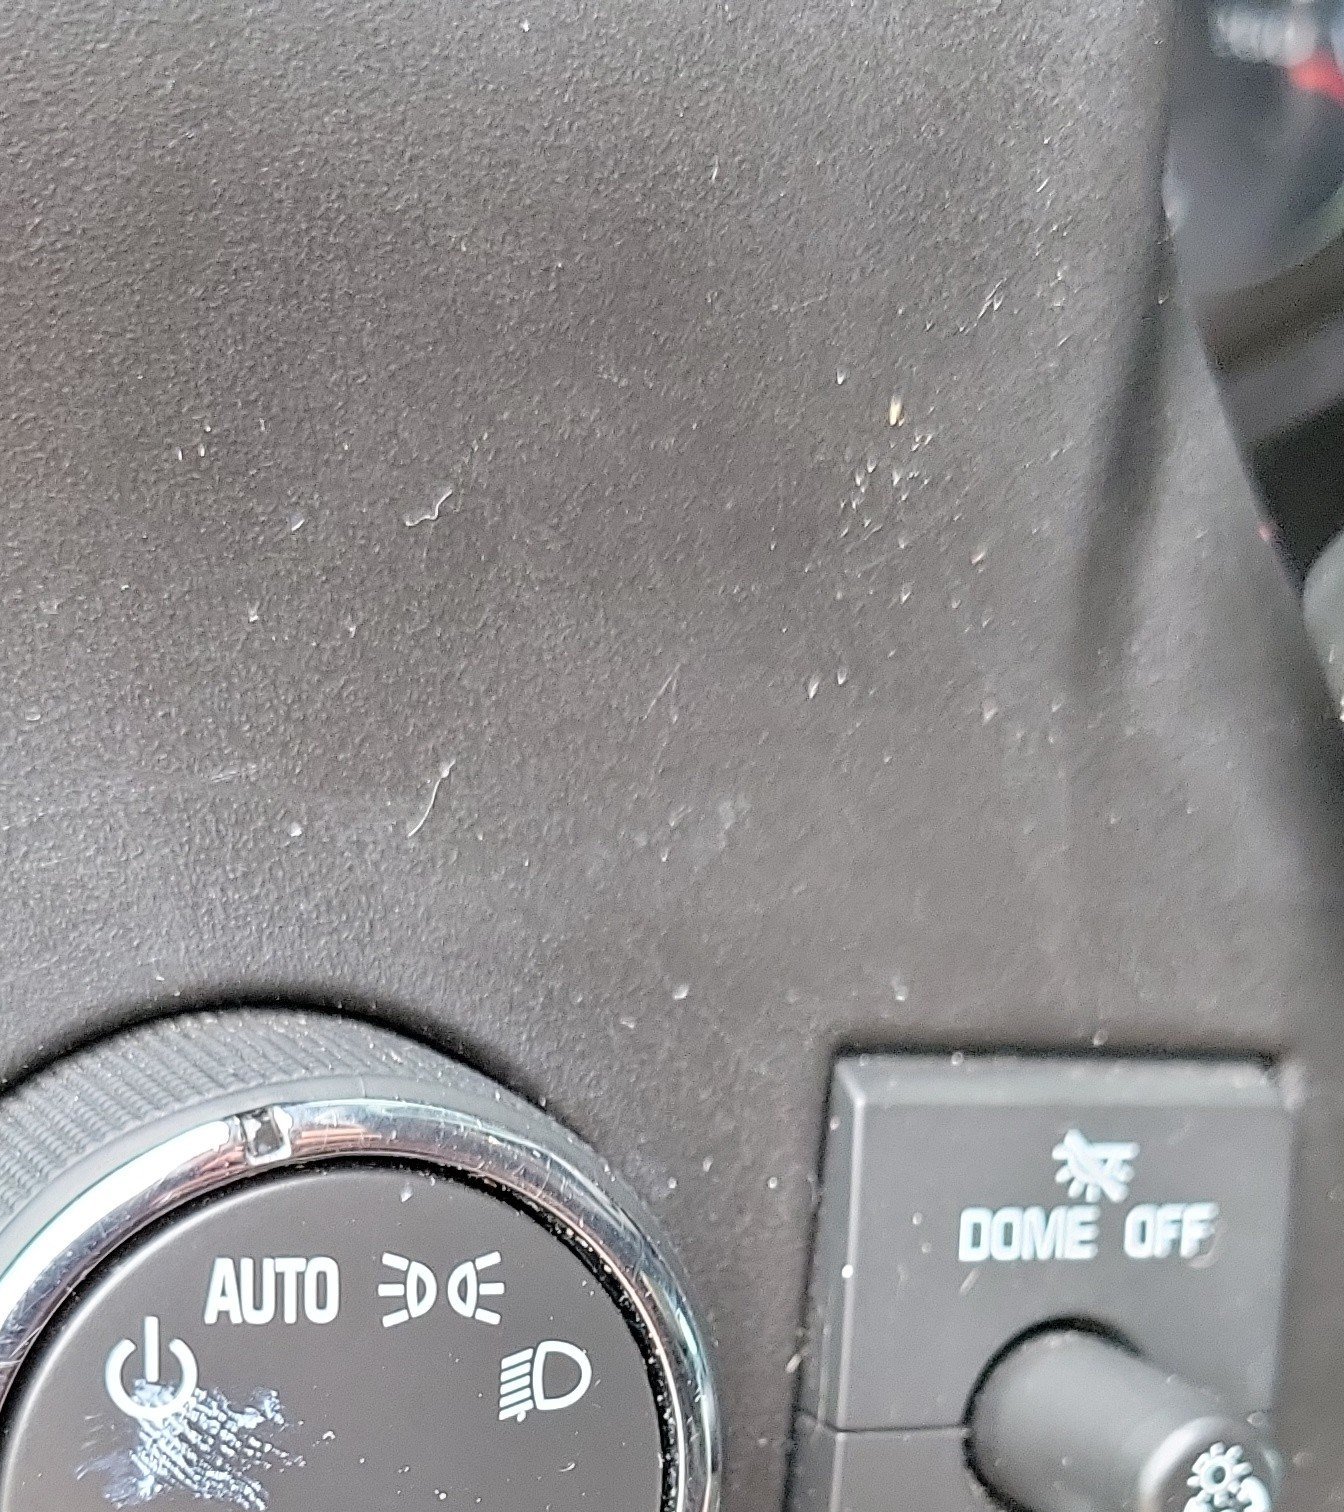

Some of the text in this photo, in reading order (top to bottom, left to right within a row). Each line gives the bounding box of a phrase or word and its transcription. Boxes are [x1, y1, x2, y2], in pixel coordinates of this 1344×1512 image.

[959, 1202, 1220, 1262] DOME OFF
[204, 1256, 340, 1325] AUTO
